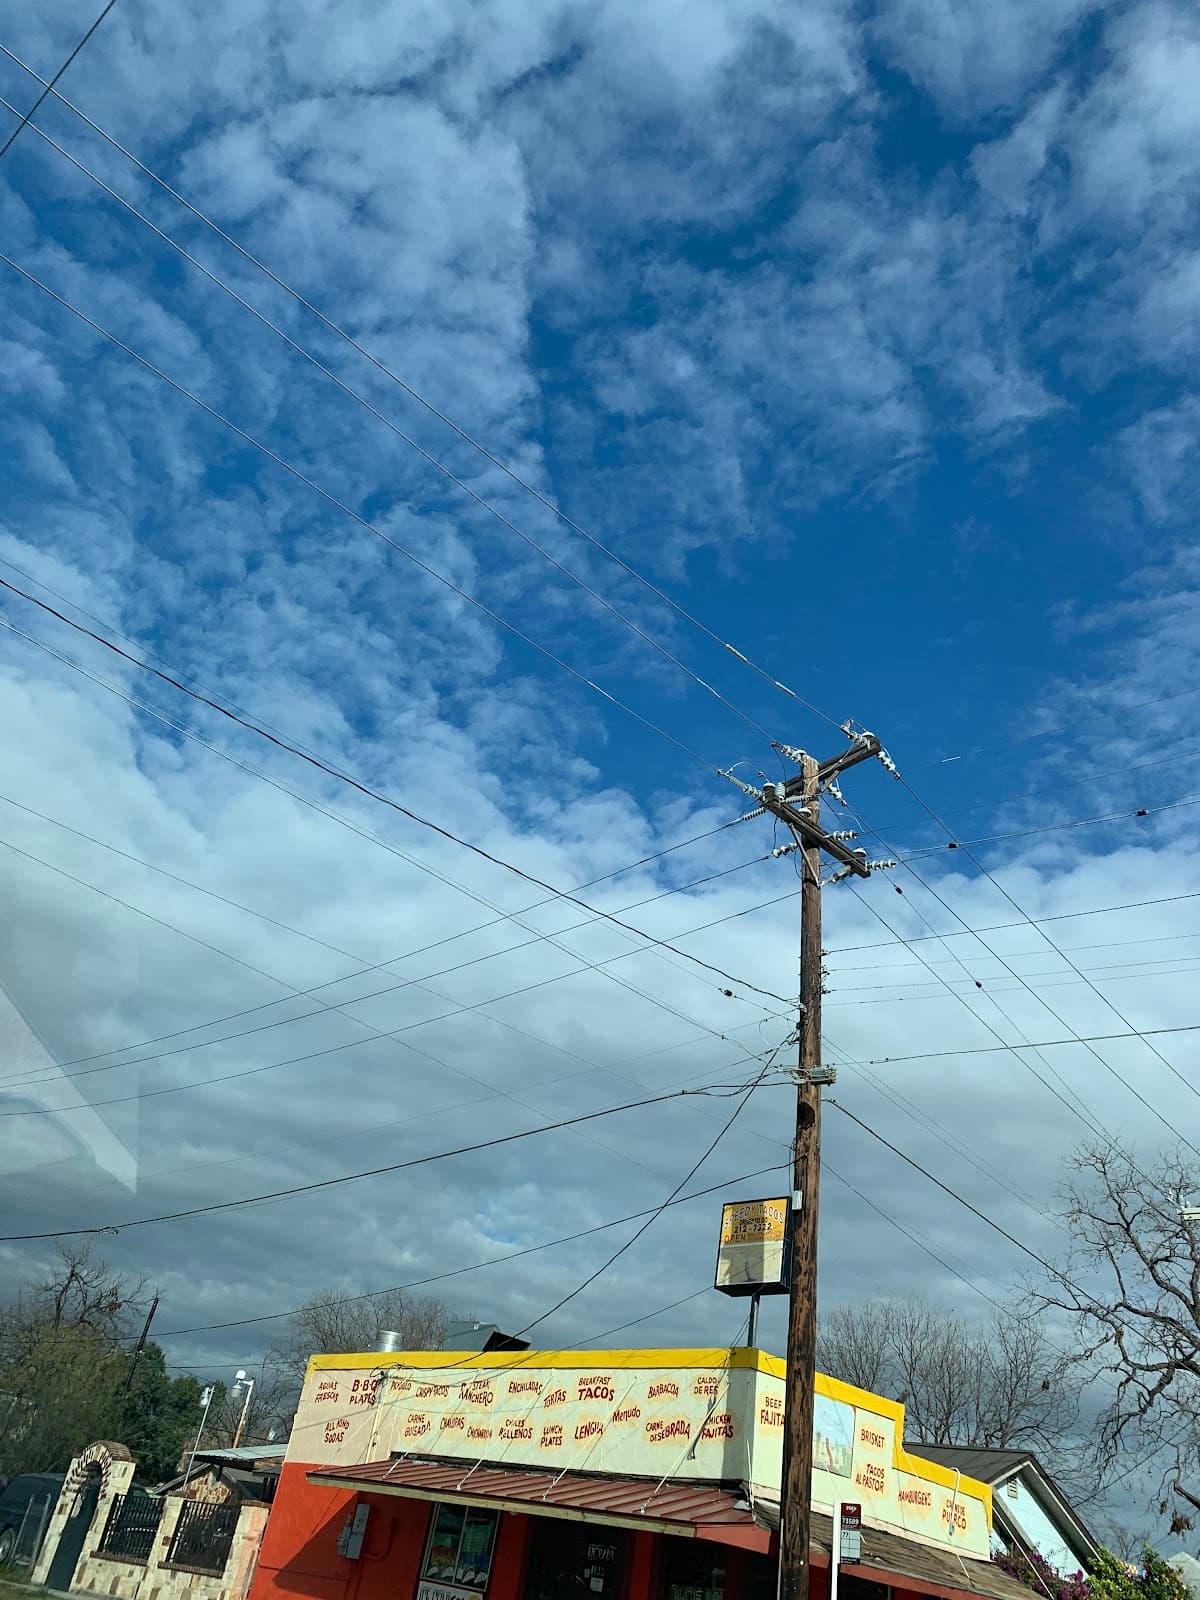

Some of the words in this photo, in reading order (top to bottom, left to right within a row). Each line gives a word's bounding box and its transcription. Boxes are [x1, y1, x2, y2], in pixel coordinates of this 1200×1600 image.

[759, 1204, 784, 1224] TACOS
[724, 1234, 746, 1244] OPEN
[318, 1381, 338, 1391] AGUAS
[472, 1379, 490, 1391] STEAK
[578, 1376, 612, 1386] BREAKFAST
[697, 1377, 717, 1385] CALDO
[415, 1386, 433, 1398] CRISPY
[433, 1385, 450, 1398] TACOS
[458, 1382, 494, 1406] RANCHERO
[508, 1381, 543, 1396] ENCHILADAS
[578, 1386, 615, 1401] TACOS
[647, 1383, 679, 1399] BARBACOA
[694, 1386, 703, 1395] DE
[704, 1385, 719, 1396] RES
[314, 1392, 339, 1404] FRESCAS
[349, 1393, 376, 1406] PLATES
[543, 1389, 567, 1408] TORTAS
[765, 1396, 782, 1409] BEEF
[407, 1414, 426, 1424] CARNE
[612, 1405, 641, 1422] Menudo
[708, 1414, 732, 1425] HICKEN
[760, 1409, 785, 1427] FAJITA
[324, 1421, 336, 1432] ALL
[336, 1418, 350, 1430] KIND
[404, 1421, 431, 1438] GUISADA
[440, 1417, 465, 1430] CHALUPAS
[645, 1420, 664, 1432] CARNE
[498, 1427, 534, 1440] RELLENOS
[543, 1425, 563, 1436] LUNCH
[574, 1421, 605, 1440] LENGUA
[650, 1420, 691, 1442] DESEBRADA
[701, 1425, 734, 1440] FAJITAS
[323, 1432, 345, 1443] SODAS
[540, 1436, 563, 1448] PLATES
[861, 1429, 885, 1448] BRISKET
[867, 1463, 885, 1479] TACOS
[855, 1473, 862, 1485] AL
[863, 1474, 885, 1494] PASTOR
[946, 1499, 960, 1514] CANE
[942, 1509, 967, 1530] PURCO
